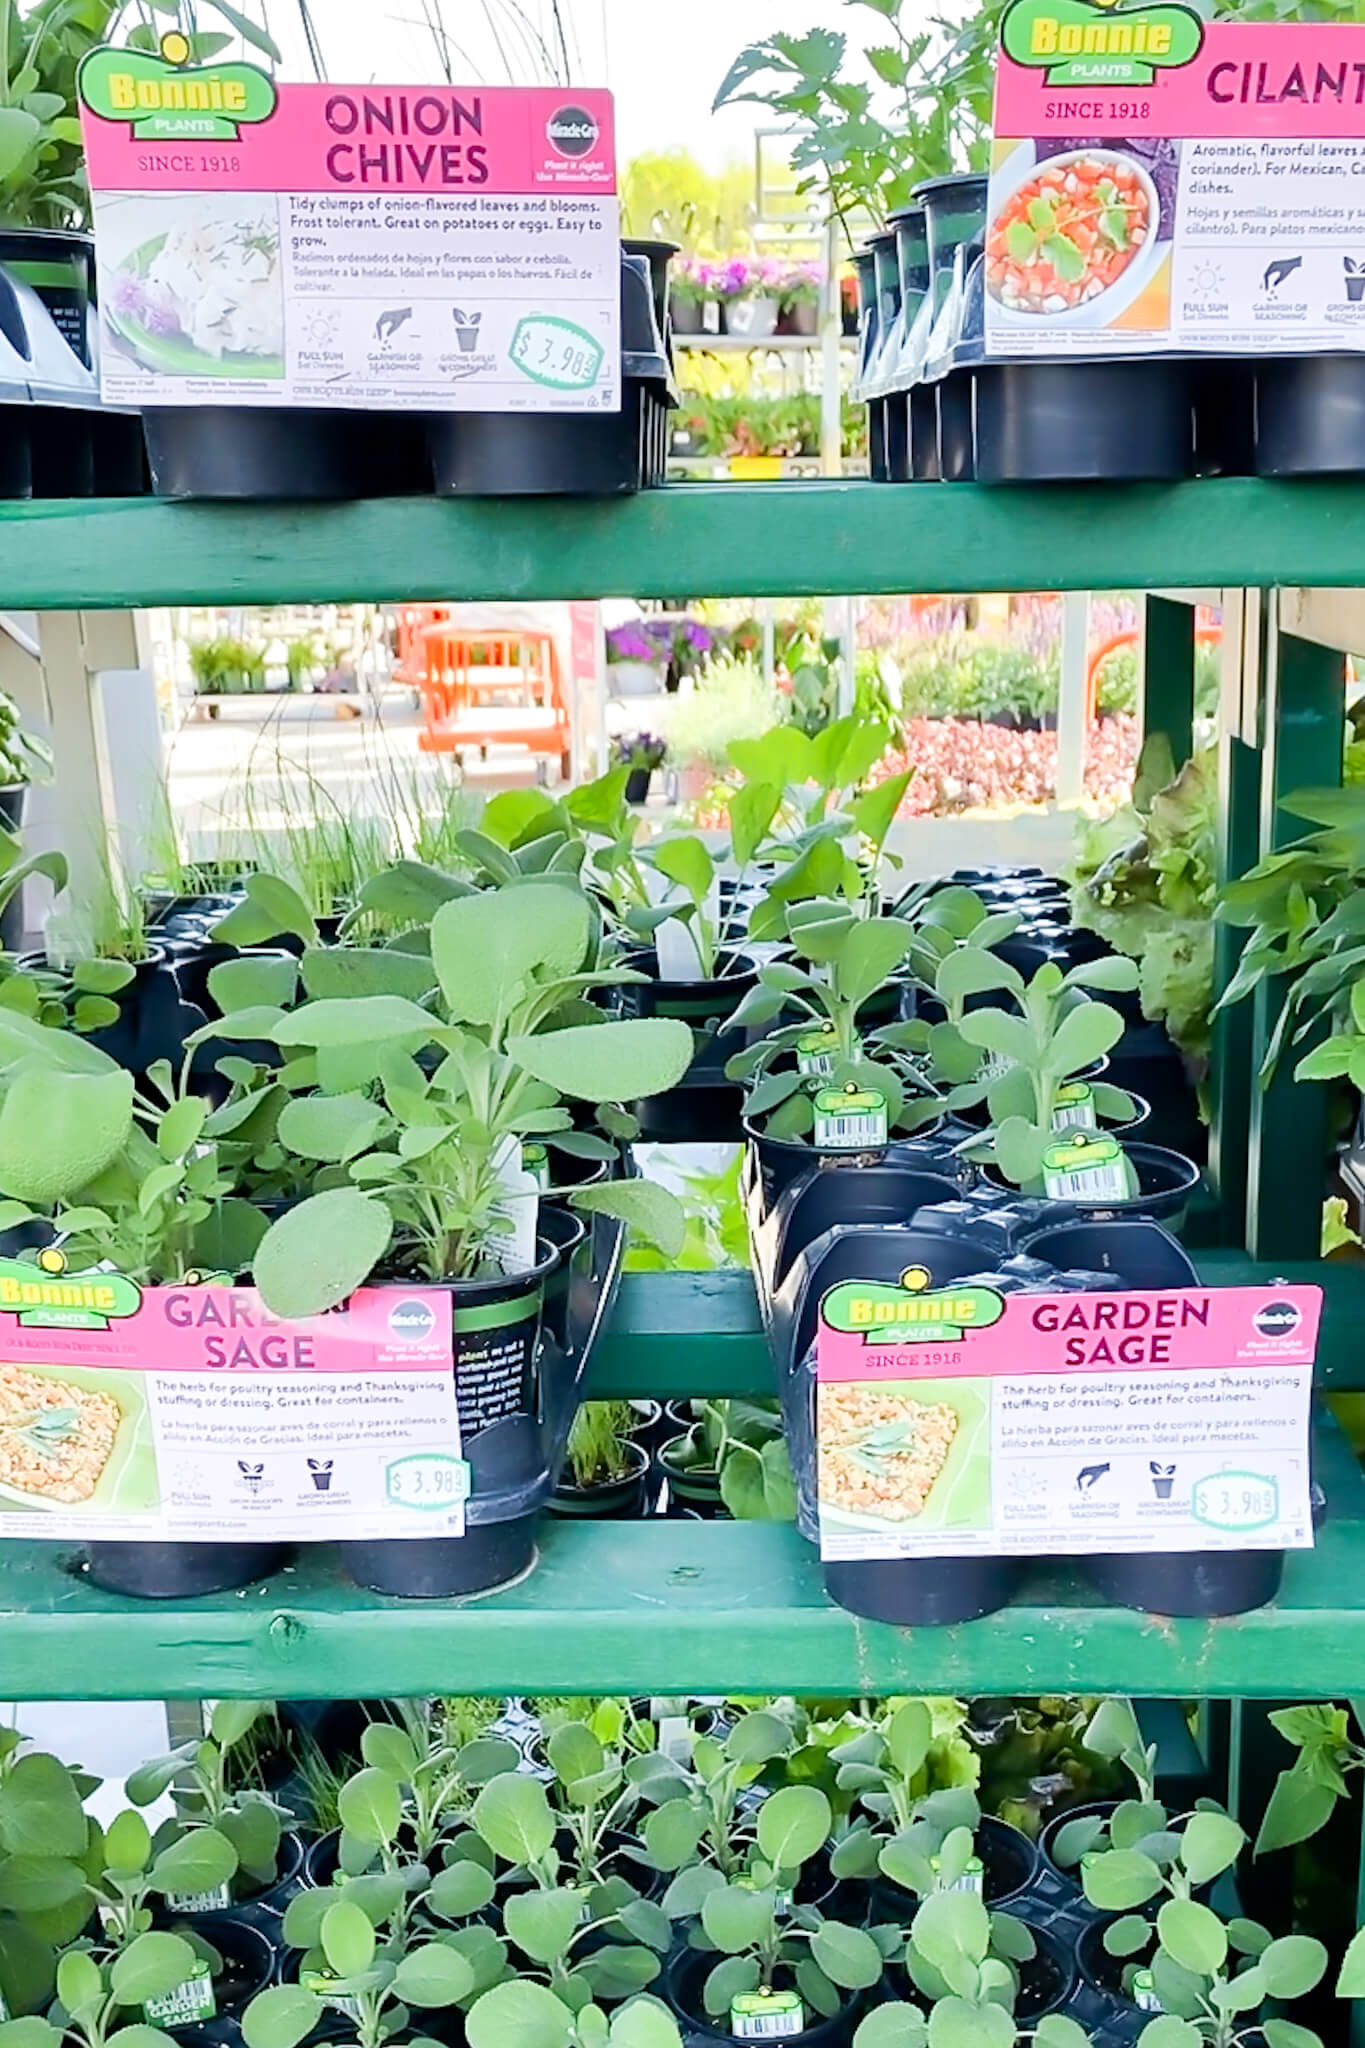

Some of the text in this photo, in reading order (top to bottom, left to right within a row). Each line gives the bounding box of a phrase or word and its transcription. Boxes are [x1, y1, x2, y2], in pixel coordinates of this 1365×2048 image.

[1031, 17, 1172, 56] Bonnie
[1071, 64, 1133, 77] PLANTS
[108, 72, 247, 110] Bonnie
[325, 95, 483, 136] ONION
[1045, 102, 1150, 119] SINCE 1918
[154, 119, 216, 132] PLANTS
[1193, 144, 1257, 157] Aromatic,
[1260, 143, 1314, 157] flavorful
[1318, 144, 1357, 157] leaves
[138, 156, 240, 172] SINCE 1918
[326, 144, 488, 184] CHIVES
[1190, 162, 1261, 176] coriander).
[1265, 162, 1286, 175] For
[1290, 162, 1347, 176] Mexican,
[1188, 181, 1234, 194] dishes.
[289, 196, 315, 213] Tidy
[319, 197, 364, 214] clumps
[385, 198, 477, 212] onion-flavored
[480, 199, 519, 212] leaves
[523, 199, 546, 212] and
[550, 199, 600, 212] blooms.
[1187, 207, 1220, 221] Hojas
[1232, 206, 1278, 218] semillas
[290, 215, 323, 228] Frost
[326, 216, 381, 228] tolerant.
[384, 216, 420, 229] Great
[443, 219, 499, 232] potatoes
[519, 220, 553, 233] eggs.
[557, 218, 585, 233] Easy
[1242, 222, 1266, 235] Para
[1270, 223, 1305, 237] platos
[291, 236, 327, 249] grow.
[519, 330, 531, 357] $
[538, 338, 584, 377] 3.98
[1, 1277, 116, 1309] Bonnie
[38, 1312, 88, 1323] PLANTS
[849, 1297, 977, 1324] Bonnie
[1032, 1299, 1210, 1332] GARDEN
[888, 1326, 942, 1338] PLANTS
[204, 1336, 315, 1369] SAGE
[1065, 1335, 1172, 1365] SAGE
[866, 1353, 961, 1368] SINCE 1918
[156, 1380, 177, 1391] The
[179, 1382, 207, 1393] herb
[209, 1382, 227, 1393] for
[230, 1384, 273, 1396] poultry
[276, 1382, 337, 1394] seasoning
[341, 1382, 362, 1392] and
[1002, 1385, 1025, 1395] The
[1027, 1384, 1056, 1395] herb
[1060, 1383, 1077, 1393] for
[1081, 1382, 1126, 1394] poultry
[1129, 1380, 1190, 1392] seasoning
[1193, 1379, 1216, 1389] and
[277, 1397, 311, 1408] Great
[315, 1396, 333, 1406] for
[1002, 1398, 1049, 1411] stuffing
[1128, 1394, 1162, 1406] Great
[1166, 1393, 1184, 1404] for
[414, 1470, 453, 1493] 3.98
[1221, 1490, 1262, 1515] 3.98
[150, 1997, 211, 2018] GARDEN
[164, 2011, 201, 2027] SAGE
